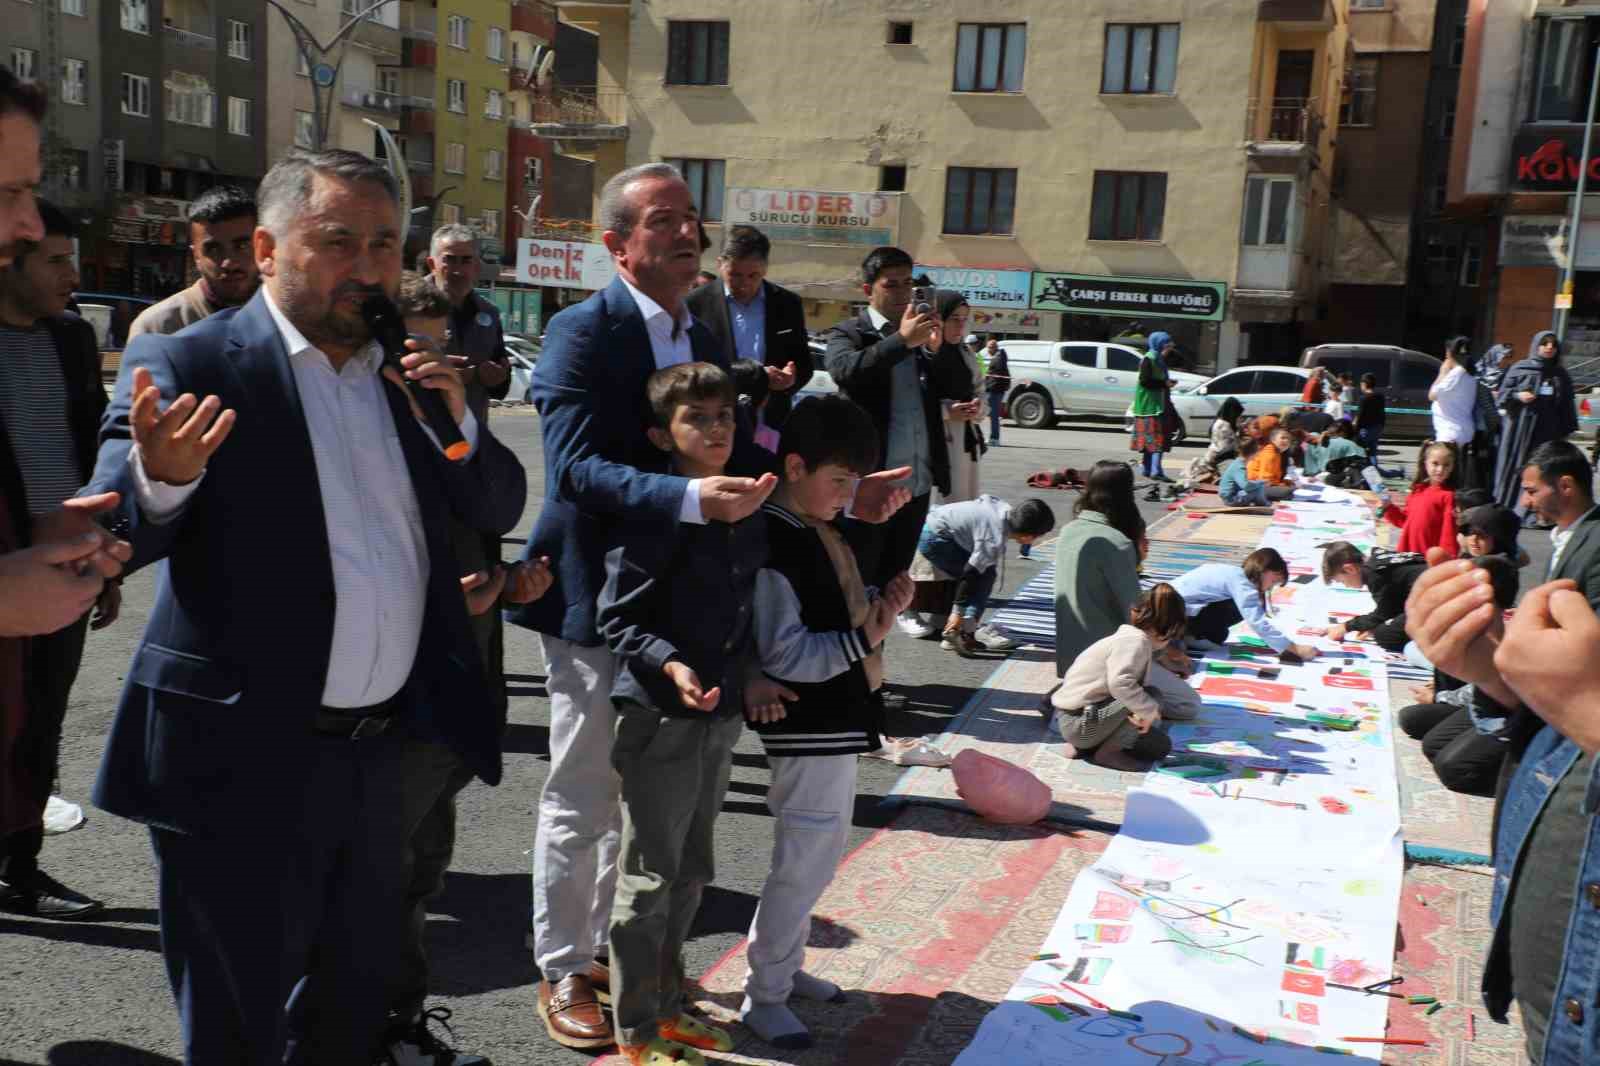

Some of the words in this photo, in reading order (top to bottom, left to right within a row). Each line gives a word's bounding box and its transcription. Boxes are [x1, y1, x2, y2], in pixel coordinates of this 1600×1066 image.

[767, 192, 853, 213] LİDER
[750, 209, 811, 224] SÜRÜCÜ
[817, 215, 870, 226] KURSU
[529, 243, 584, 262] Deniz
[528, 263, 582, 281] Optik
[974, 288, 1025, 303] TEMİZLİK
[1070, 288, 1107, 303] ÇARŞI
[1110, 291, 1149, 304] ERKEK
[1152, 293, 1212, 307] KUAFÖRÜ
